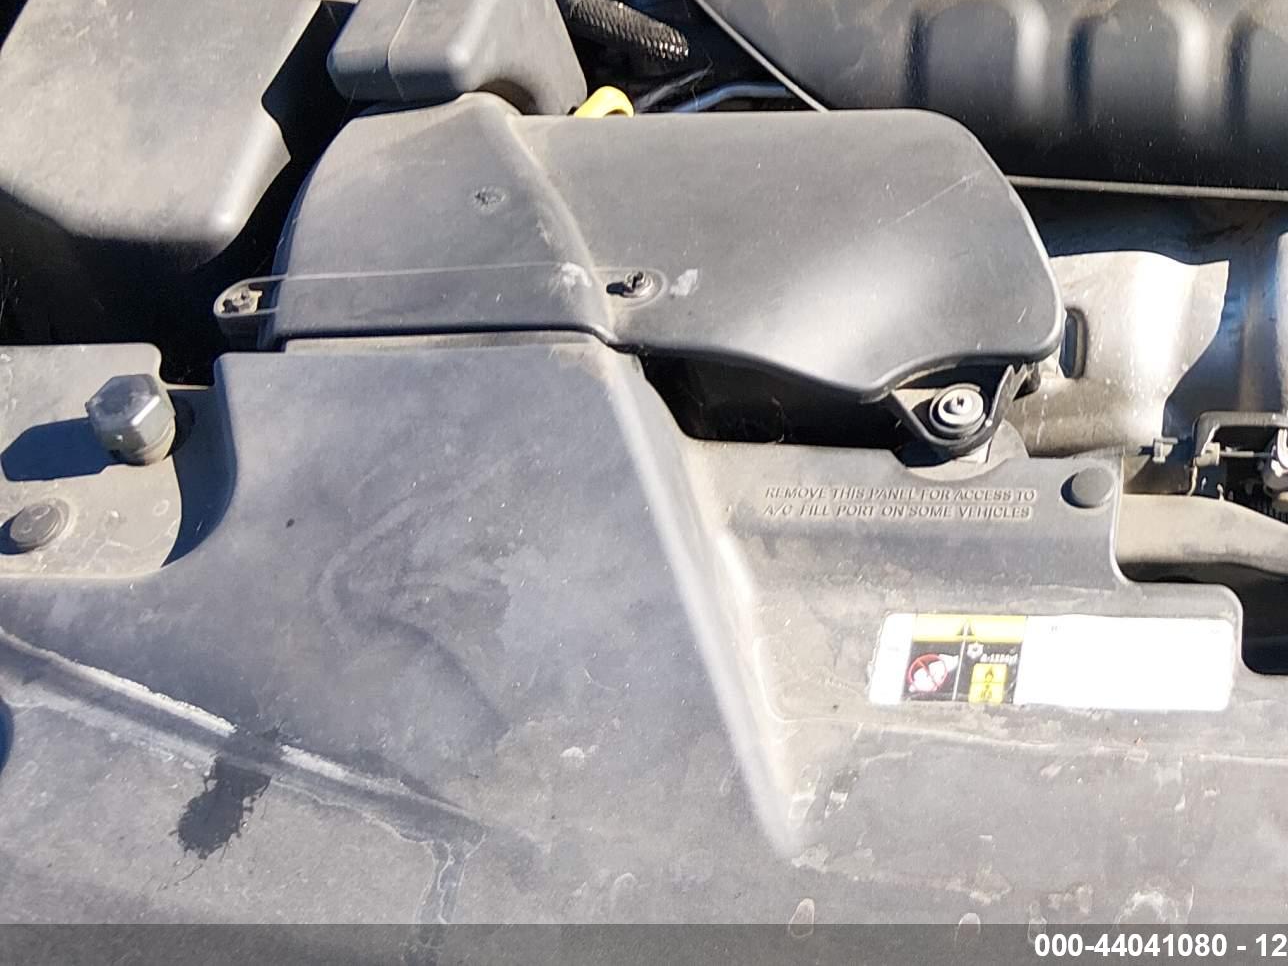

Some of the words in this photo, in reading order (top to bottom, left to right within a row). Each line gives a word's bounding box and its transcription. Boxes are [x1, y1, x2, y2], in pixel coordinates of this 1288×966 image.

[764, 487, 827, 500] REMOVE
[832, 487, 865, 501] THIS
[869, 488, 916, 501] PANEL
[920, 488, 951, 502] FOR
[953, 489, 1013, 503] ACCESS
[1017, 489, 1037, 503] TO
[763, 503, 793, 516] A/C
[799, 504, 829, 517] FILL
[836, 504, 875, 517] PORT
[881, 504, 905, 518] ON
[908, 505, 951, 518] SOME
[959, 505, 1032, 520] VEHICLES
